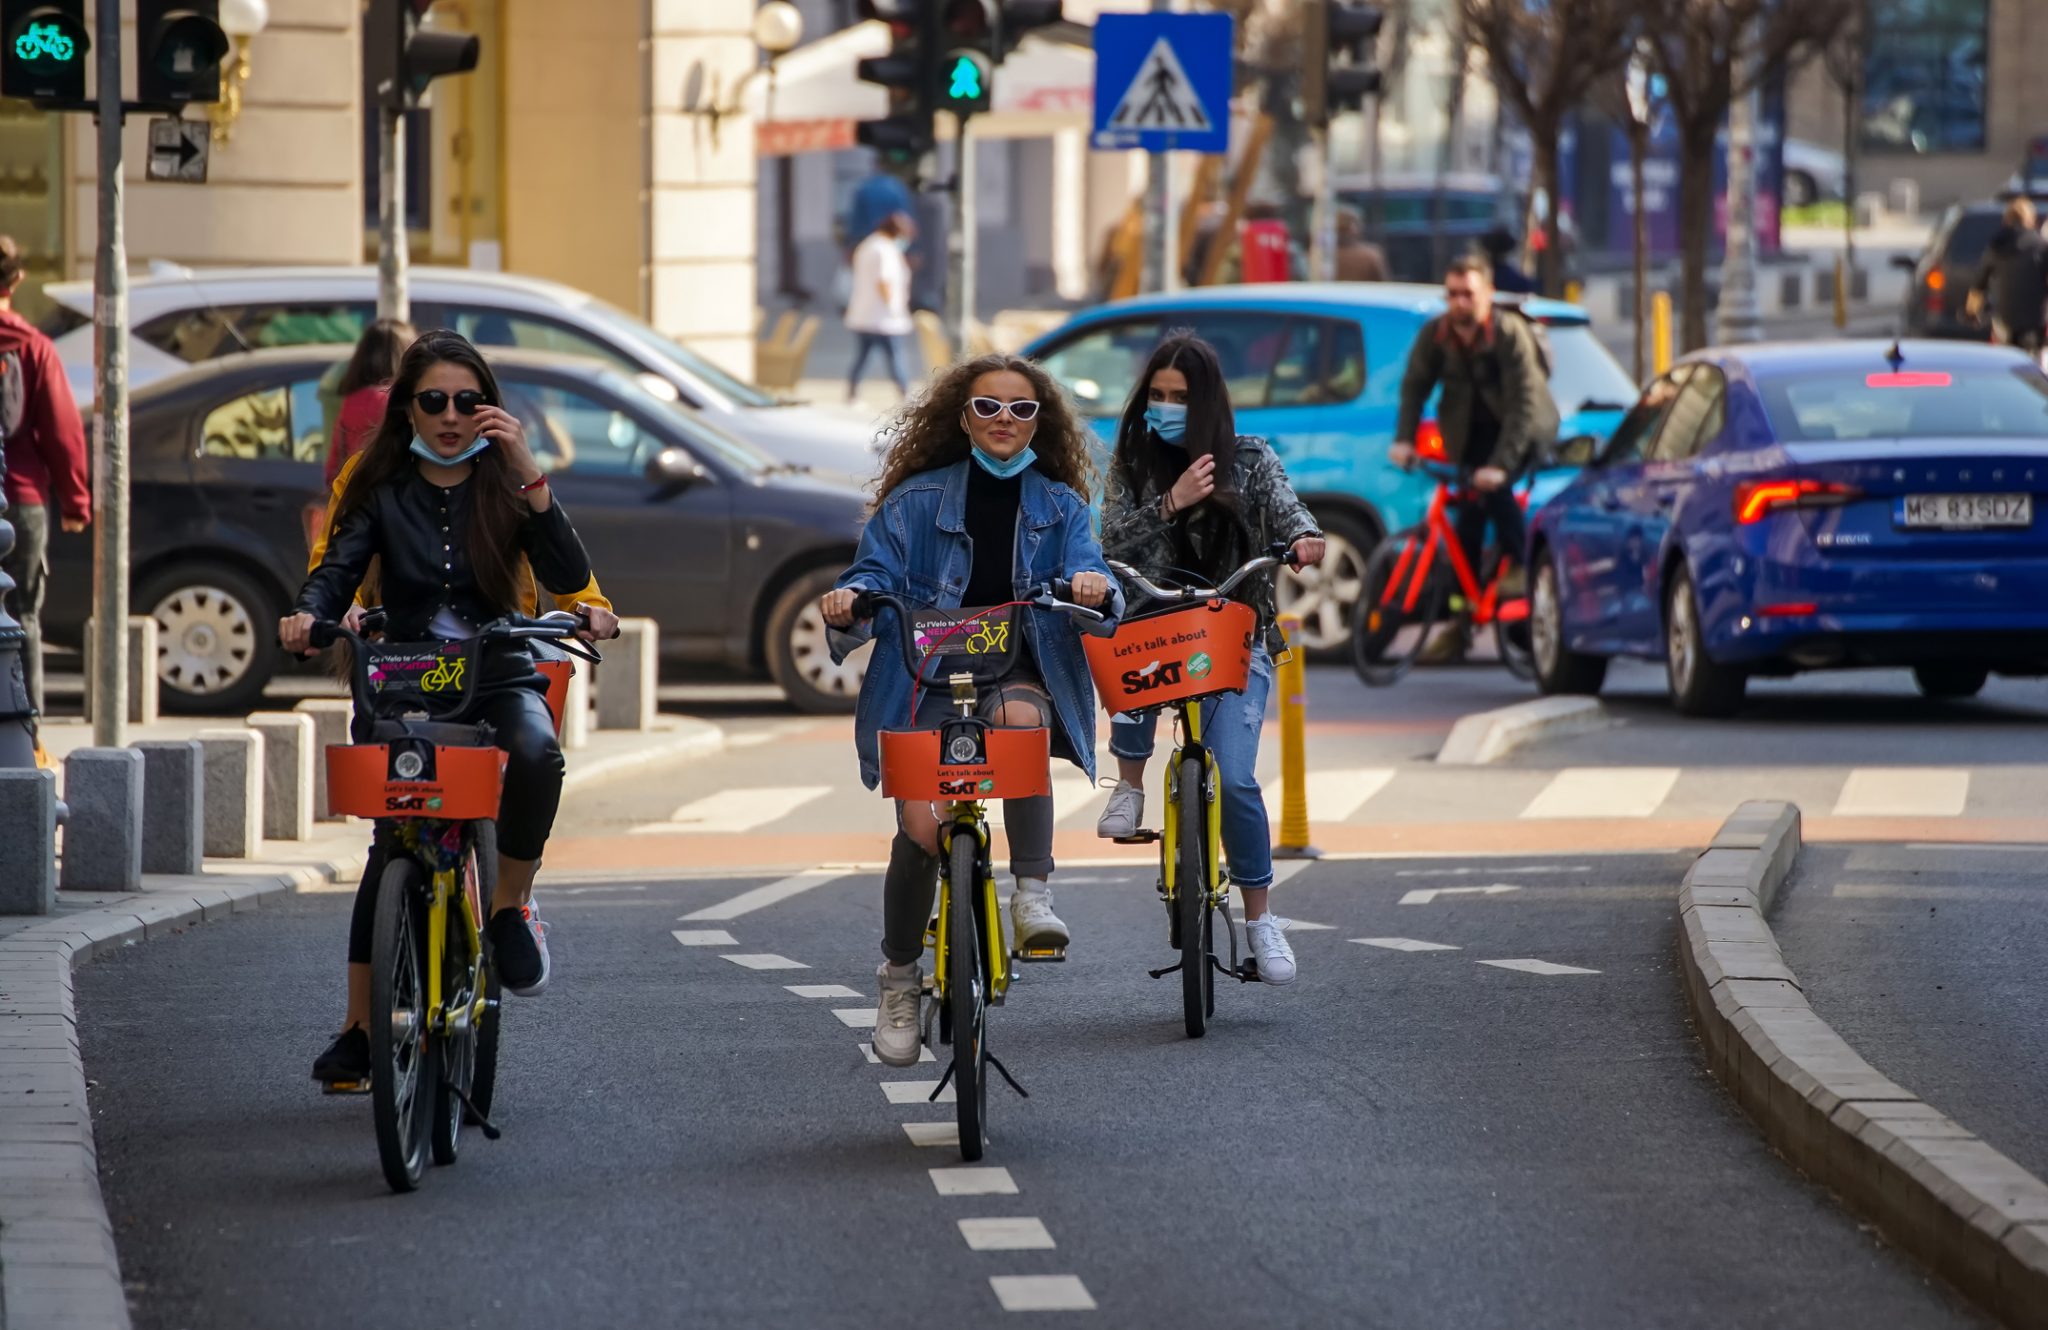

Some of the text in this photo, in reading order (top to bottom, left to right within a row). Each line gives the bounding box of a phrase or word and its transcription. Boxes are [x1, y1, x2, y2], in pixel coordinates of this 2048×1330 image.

[915, 621, 926, 629] Cu
[1114, 628, 1208, 658] Let's talk about
[937, 769, 994, 777] Let's talk about
